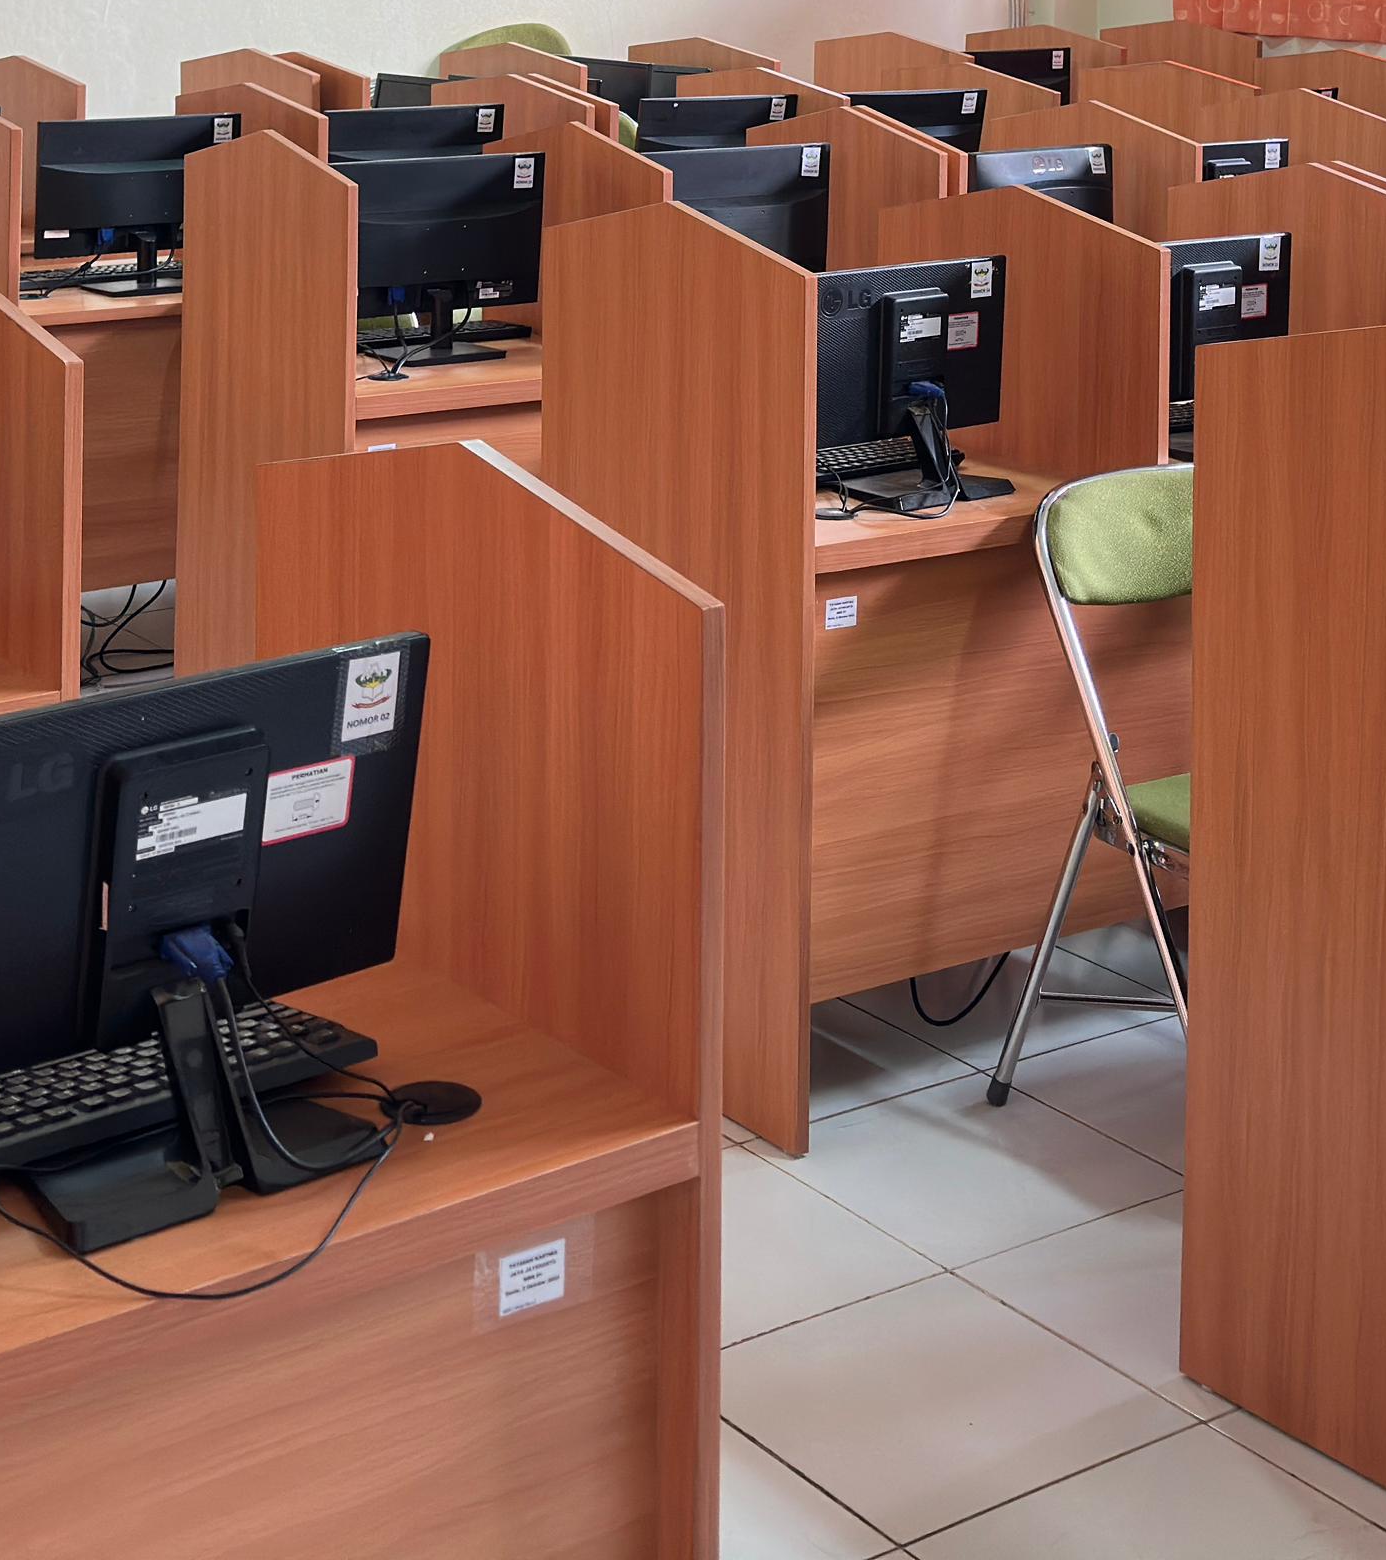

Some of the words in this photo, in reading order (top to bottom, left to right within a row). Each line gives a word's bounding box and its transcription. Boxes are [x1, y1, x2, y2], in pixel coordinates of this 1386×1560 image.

[346, 716, 379, 729] NOMOR
[380, 712, 390, 721] 02
[291, 767, 328, 781] PERHATIAN
